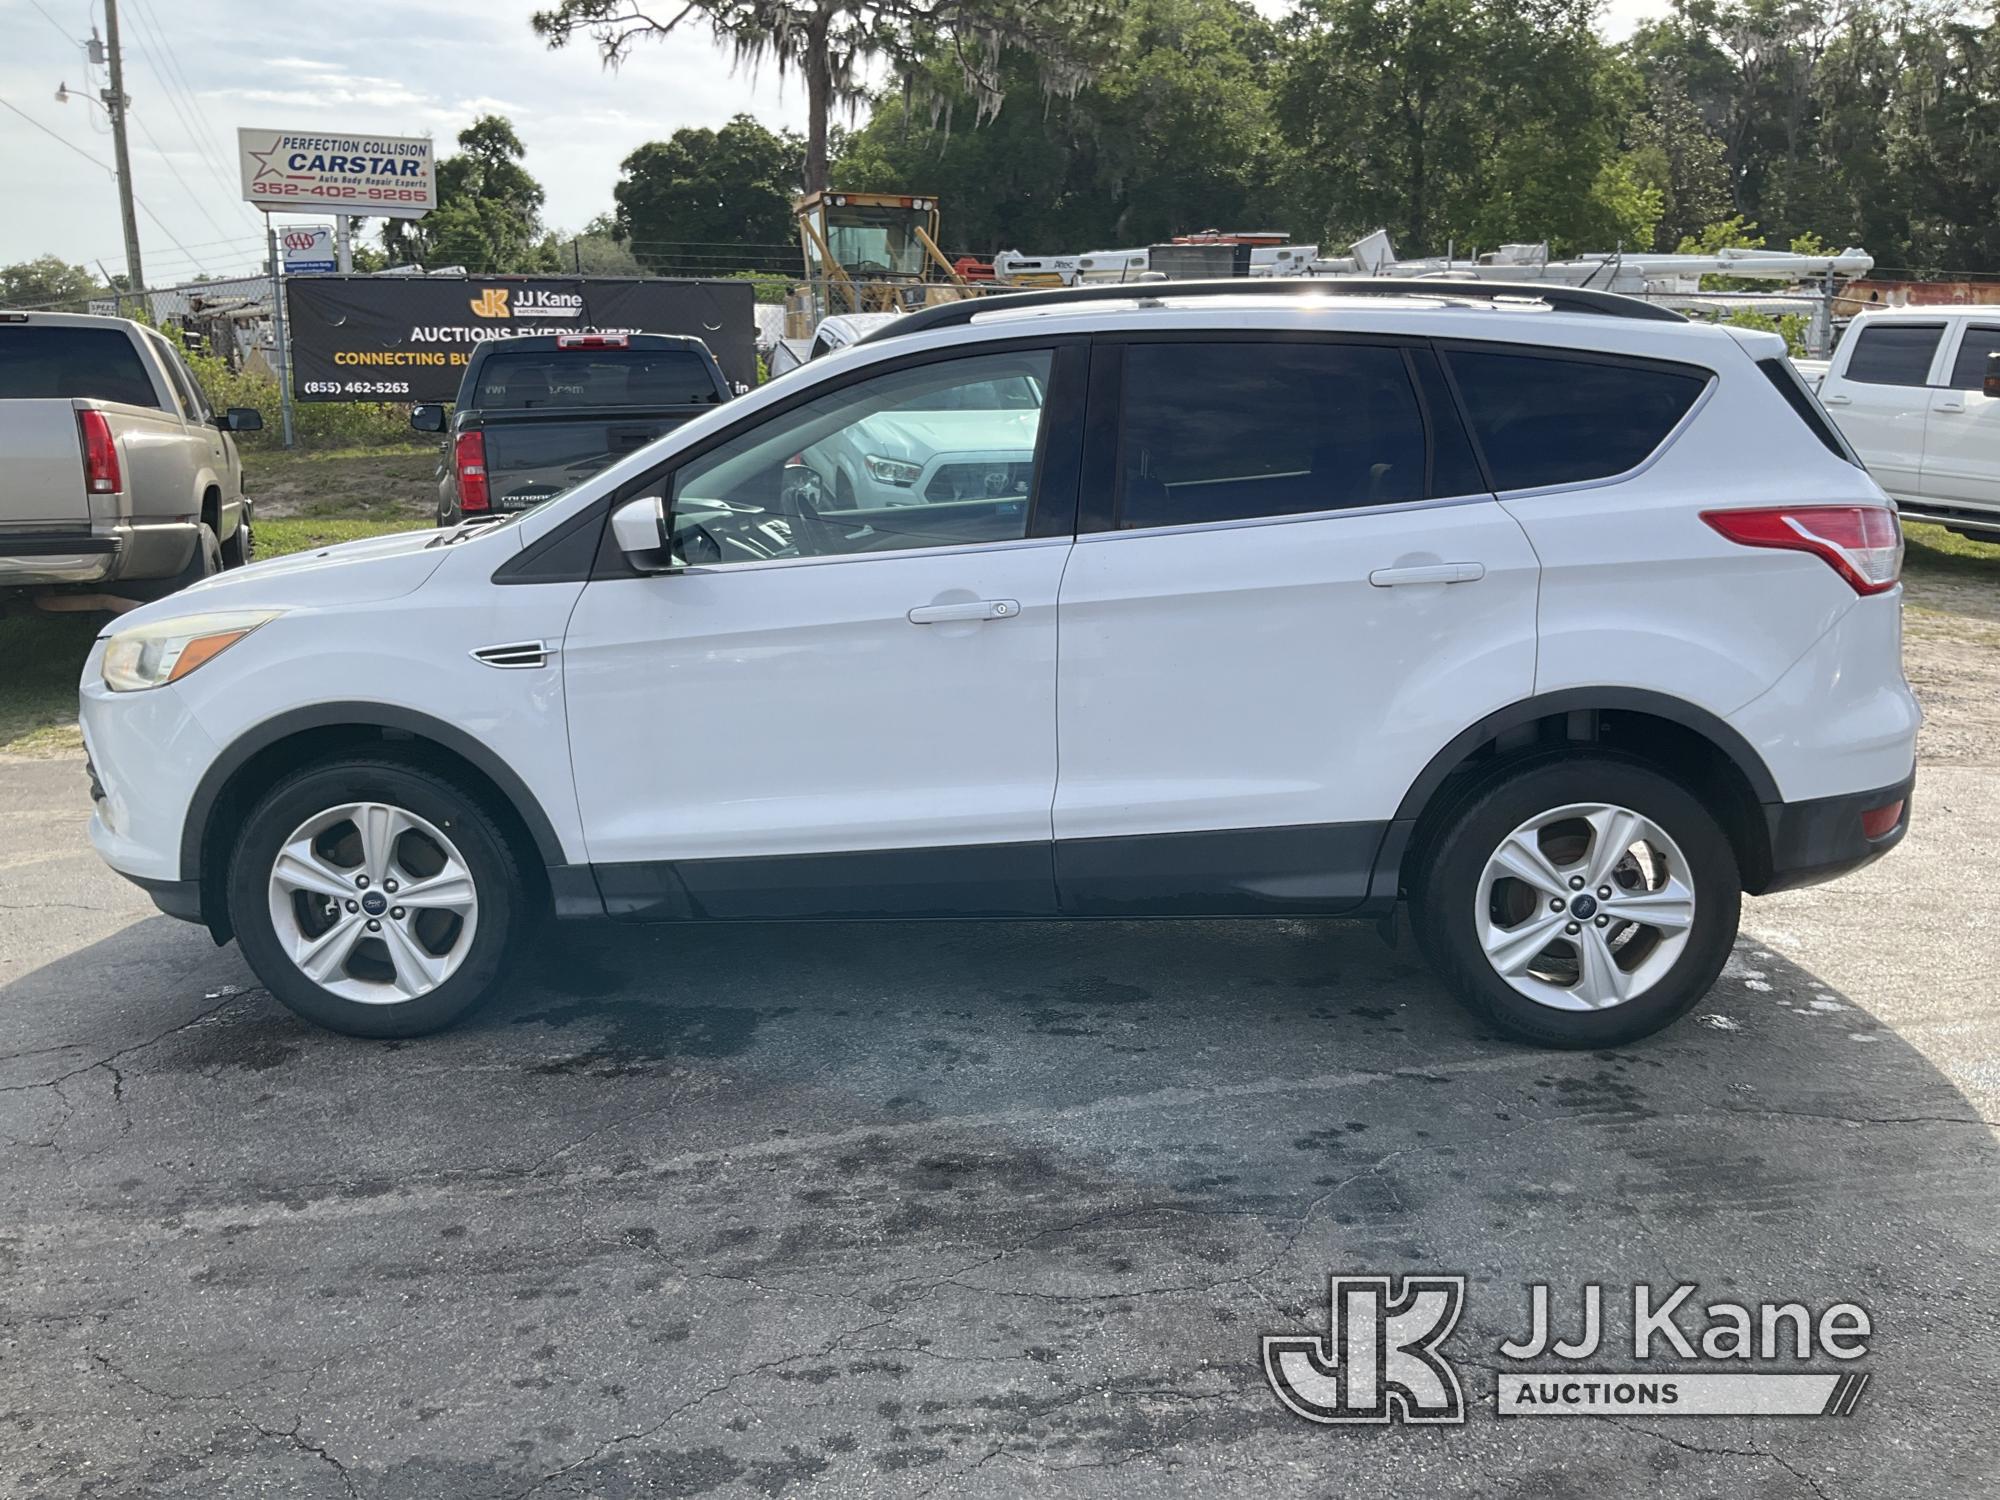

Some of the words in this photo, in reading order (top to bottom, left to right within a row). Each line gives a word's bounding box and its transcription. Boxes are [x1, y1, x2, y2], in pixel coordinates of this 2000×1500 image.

[282, 137, 360, 153] PERFECTION
[363, 142, 427, 157] COLLISION
[288, 153, 420, 177] CARSTAR
[318, 175, 338, 183] Auto
[341, 176, 361, 185] Body
[365, 178, 392, 187] Repair
[395, 179, 427, 188] Experts
[252, 182, 427, 202] 352-402-9285
[513, 291, 534, 306] JJ
[537, 291, 582, 307] Kane
[410, 327, 511, 342] AUCTIONS
[334, 352, 446, 366] CONNECTING
[304, 382, 341, 394] (855)
[345, 382, 409, 393] 462-5263
